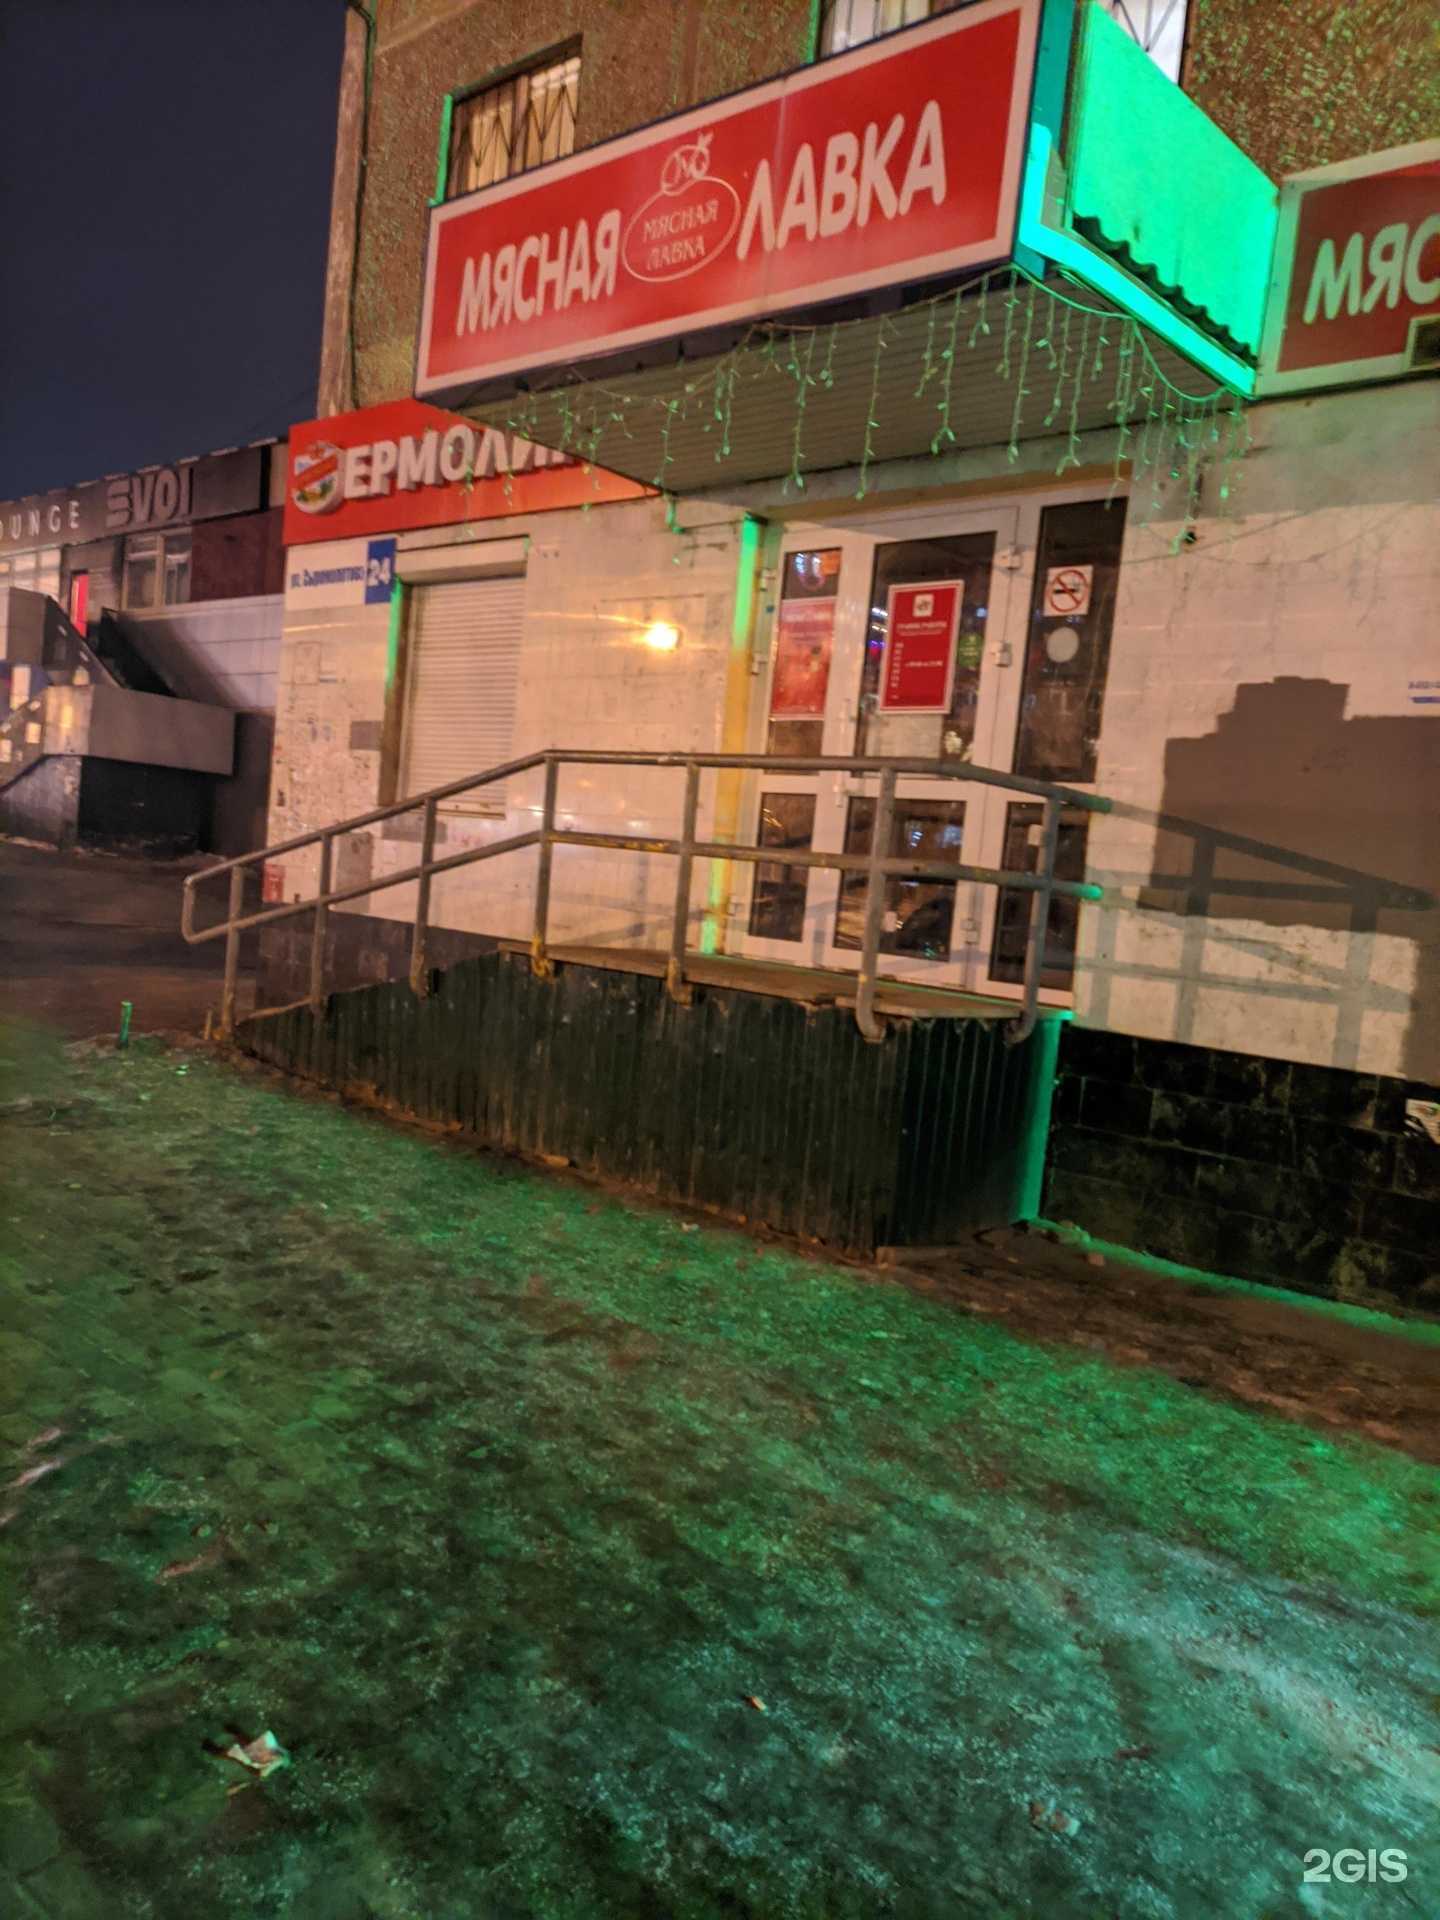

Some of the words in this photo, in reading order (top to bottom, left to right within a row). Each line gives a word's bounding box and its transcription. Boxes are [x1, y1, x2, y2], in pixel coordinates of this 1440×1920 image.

[456, 208, 621, 337] МЯСНАЯ
[736, 100, 947, 260] ЛАВКА
[643, 198, 719, 242] МЯСНАЯ
[646, 235, 706, 271] ЛАВКА
[344, 423, 566, 499] ЕРМОЛИ
[367, 556, 391, 587] 24
